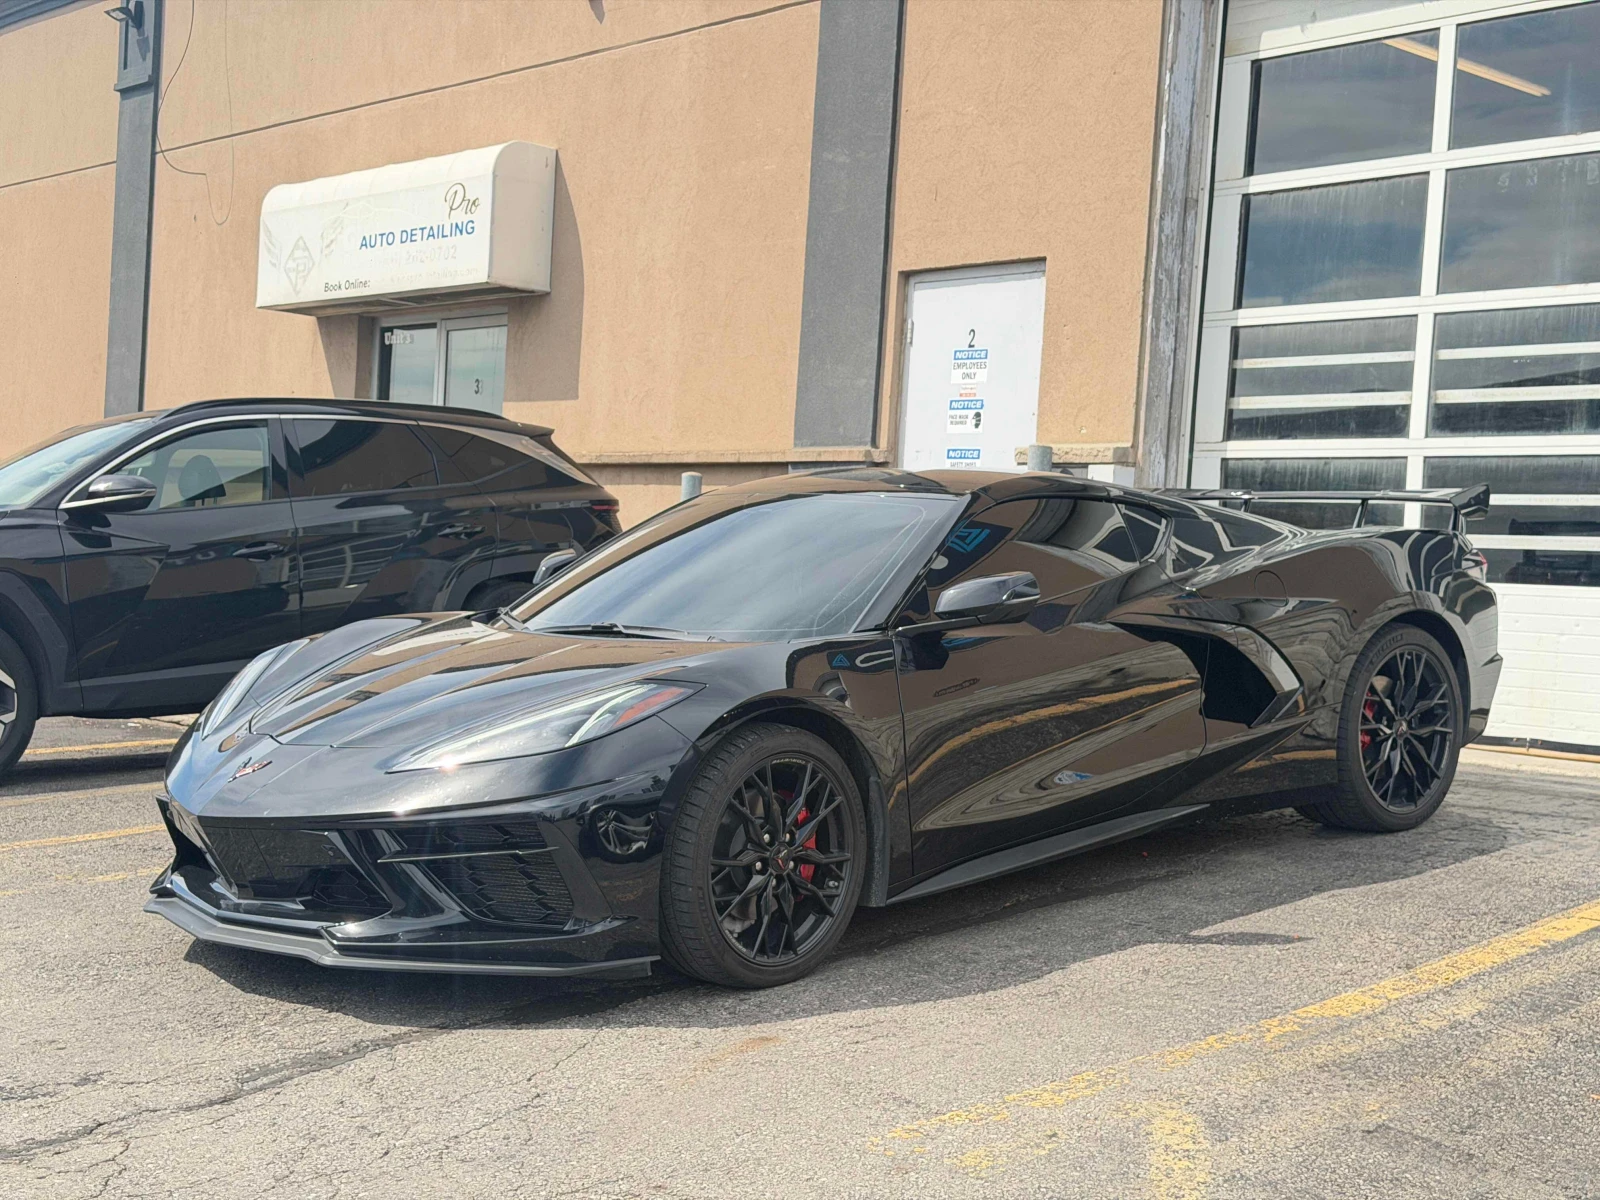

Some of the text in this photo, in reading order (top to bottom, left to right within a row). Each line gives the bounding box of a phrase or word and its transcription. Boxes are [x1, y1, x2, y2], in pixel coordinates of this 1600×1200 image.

[444, 182, 480, 220] Pro
[359, 219, 475, 250] AUTO DETAILING
[324, 279, 371, 292] Book Online:
[968, 328, 976, 348] 2
[954, 350, 987, 359] NOTICE
[953, 361, 987, 370] EMPLOYEES
[961, 372, 977, 380] ONLY
[950, 400, 983, 409] NOTICE
[948, 450, 980, 459] NOTICE
